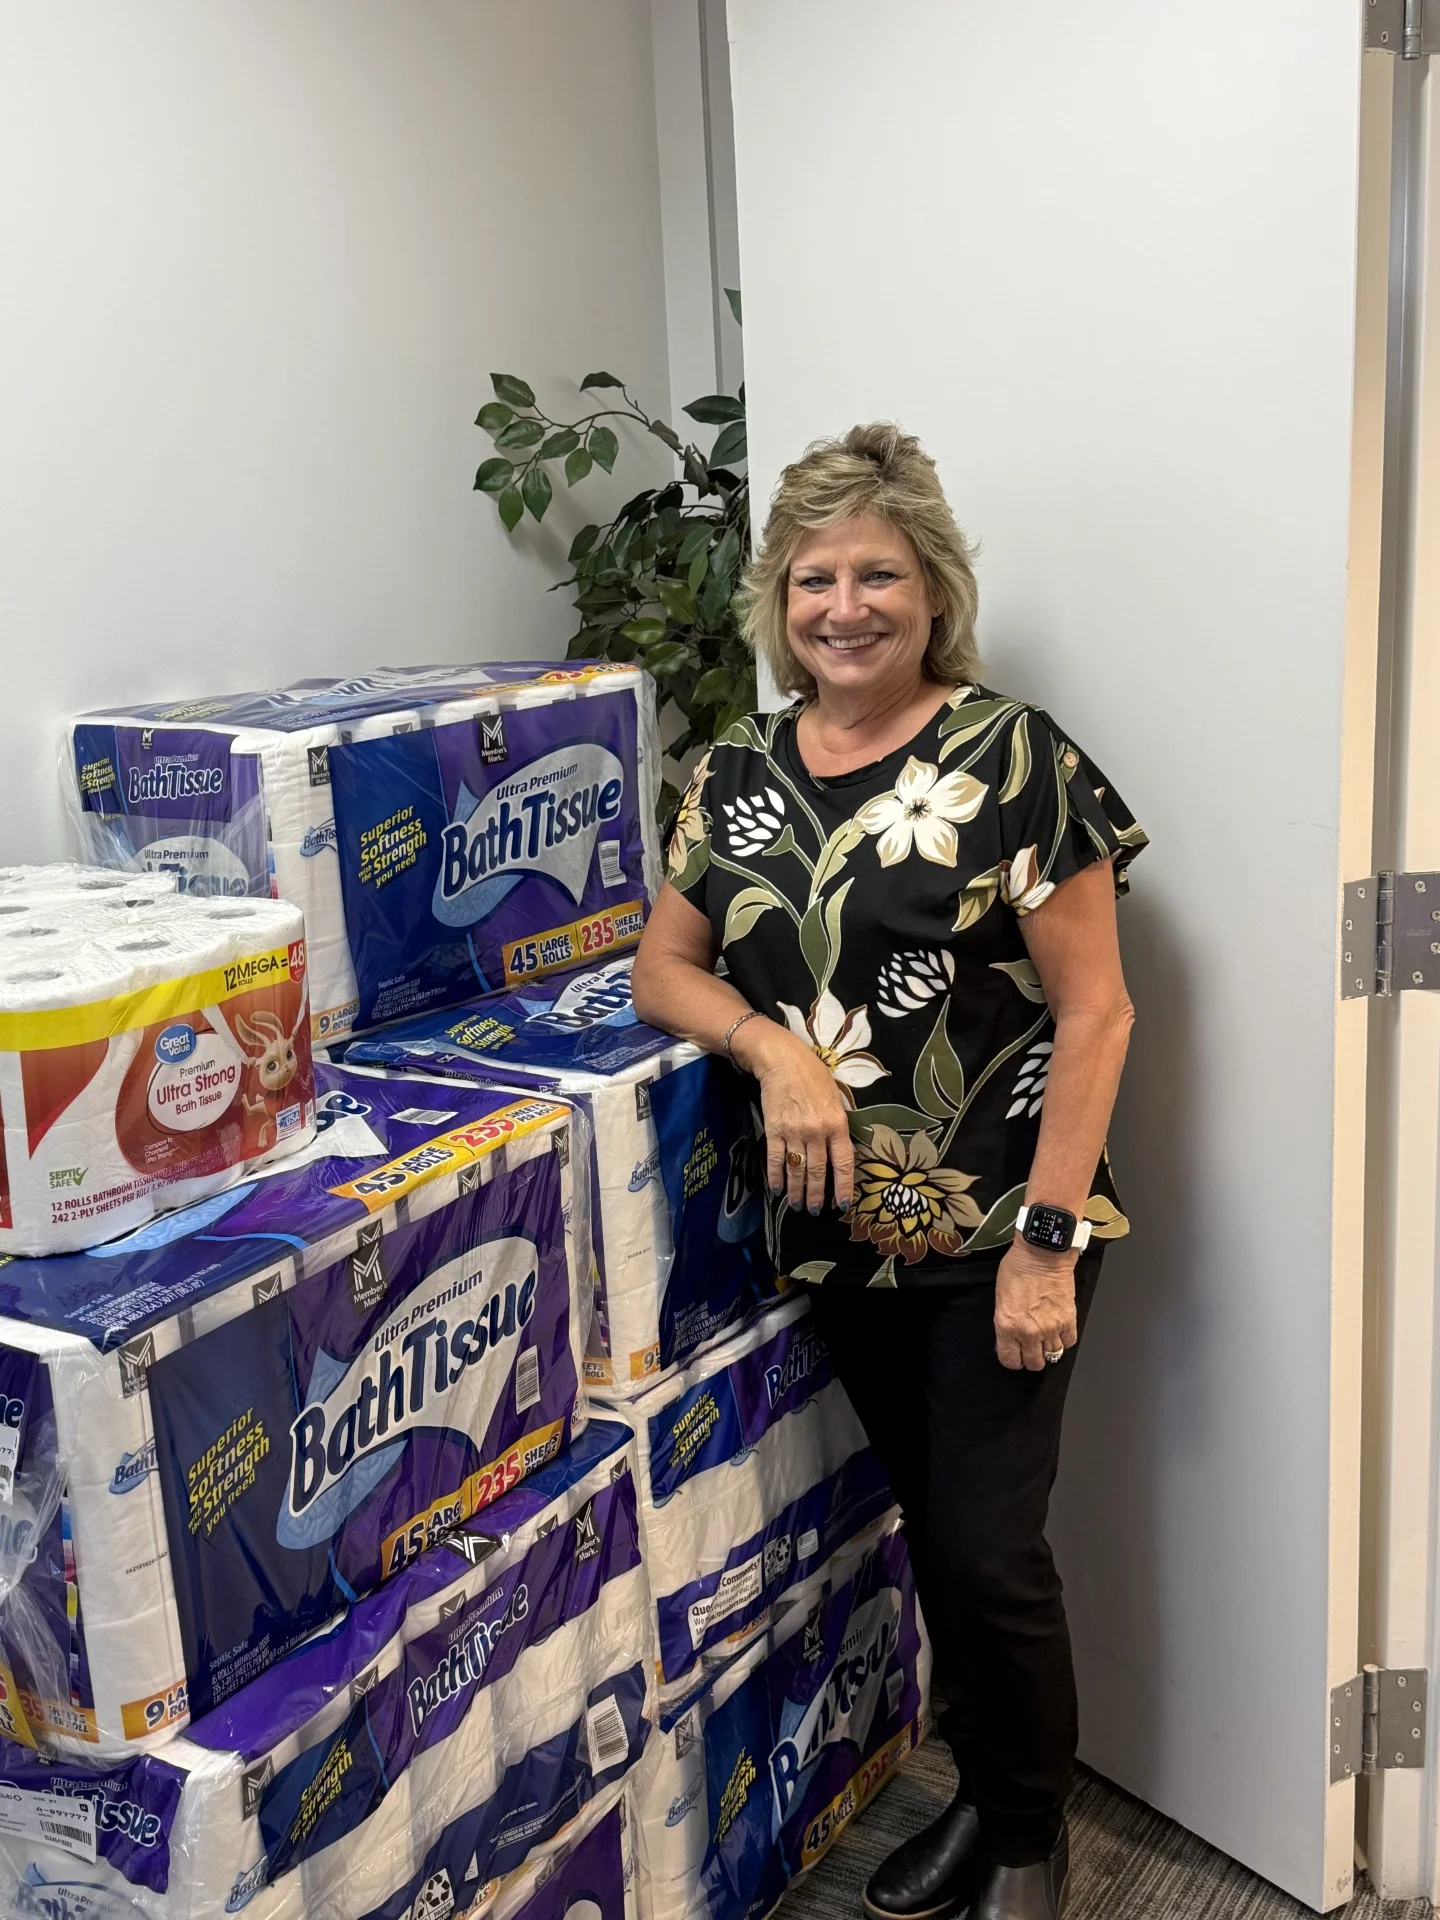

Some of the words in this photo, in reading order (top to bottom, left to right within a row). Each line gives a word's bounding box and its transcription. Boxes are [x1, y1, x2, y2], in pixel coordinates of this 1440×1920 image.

[154, 755, 170, 765] Ultra
[481, 747, 508, 758] Member's
[487, 755, 503, 764] Mark
[80, 765, 113, 783] Softness
[86, 773, 116, 789] Strength
[496, 782, 528, 801] Ultra
[529, 763, 579, 791] Premium
[163, 848, 210, 860] Premium
[360, 817, 422, 867] Softness
[373, 829, 427, 876] Strength
[375, 868, 393, 889] you
[394, 851, 417, 874] need
[508, 940, 541, 977] 45
[540, 932, 571, 954] LARGE
[580, 914, 616, 954] 235
[617, 927, 629, 940] PER
[223, 966, 238, 992] 12
[237, 955, 280, 980] MEGA
[290, 942, 305, 969] 48
[238, 978, 254, 987] ROLLS
[570, 975, 602, 994] Ultra
[319, 1014, 331, 1036] 9
[331, 1003, 359, 1022] LARGE
[456, 1016, 500, 1045] Softness
[159, 1031, 191, 1051] Great
[474, 1024, 516, 1048] Strength
[167, 1043, 192, 1058] Value
[179, 1058, 217, 1079] Premium
[156, 1081, 192, 1106] Ultra
[195, 1064, 237, 1095] Strong
[175, 1099, 198, 1116] Bath
[199, 1090, 223, 1108] Tissue
[503, 1100, 549, 1120] SHEETS
[285, 1110, 300, 1126] USA
[353, 1170, 410, 1198] 45
[392, 1145, 441, 1174] LARGE
[448, 1116, 518, 1149] 235
[409, 1147, 458, 1175] ROLLS
[49, 1166, 82, 1181] SEPTIC
[49, 1178, 73, 1190] SAFE
[51, 1201, 63, 1212] 12
[64, 1196, 92, 1211] ROLLS
[92, 1181, 134, 1204] BATHROOM
[51, 1213, 70, 1225] 242
[70, 1209, 96, 1222] 2-PLY
[96, 1198, 122, 1217] SHEETS
[122, 1192, 136, 1206] PER
[353, 1280, 388, 1304] Member's
[363, 1294, 384, 1310] Mark
[373, 1315, 410, 1353] Ultra
[410, 1269, 483, 1325] Premium
[582, 1361, 605, 1371] EETS
[680, 1407, 720, 1458] Strength
[189, 1419, 264, 1514] Softness
[203, 1436, 270, 1519] Strength
[206, 1502, 226, 1537] you
[227, 1468, 256, 1505] need
[387, 1520, 426, 1575] 45
[474, 1449, 522, 1513] 235
[209, 1651, 233, 1672] Septic
[232, 1640, 250, 1657] Safe
[143, 1697, 166, 1731] 9
[51, 1776, 79, 1790] Ultra
[318, 1779, 342, 1814] need
[806, 1811, 833, 1853] 45
